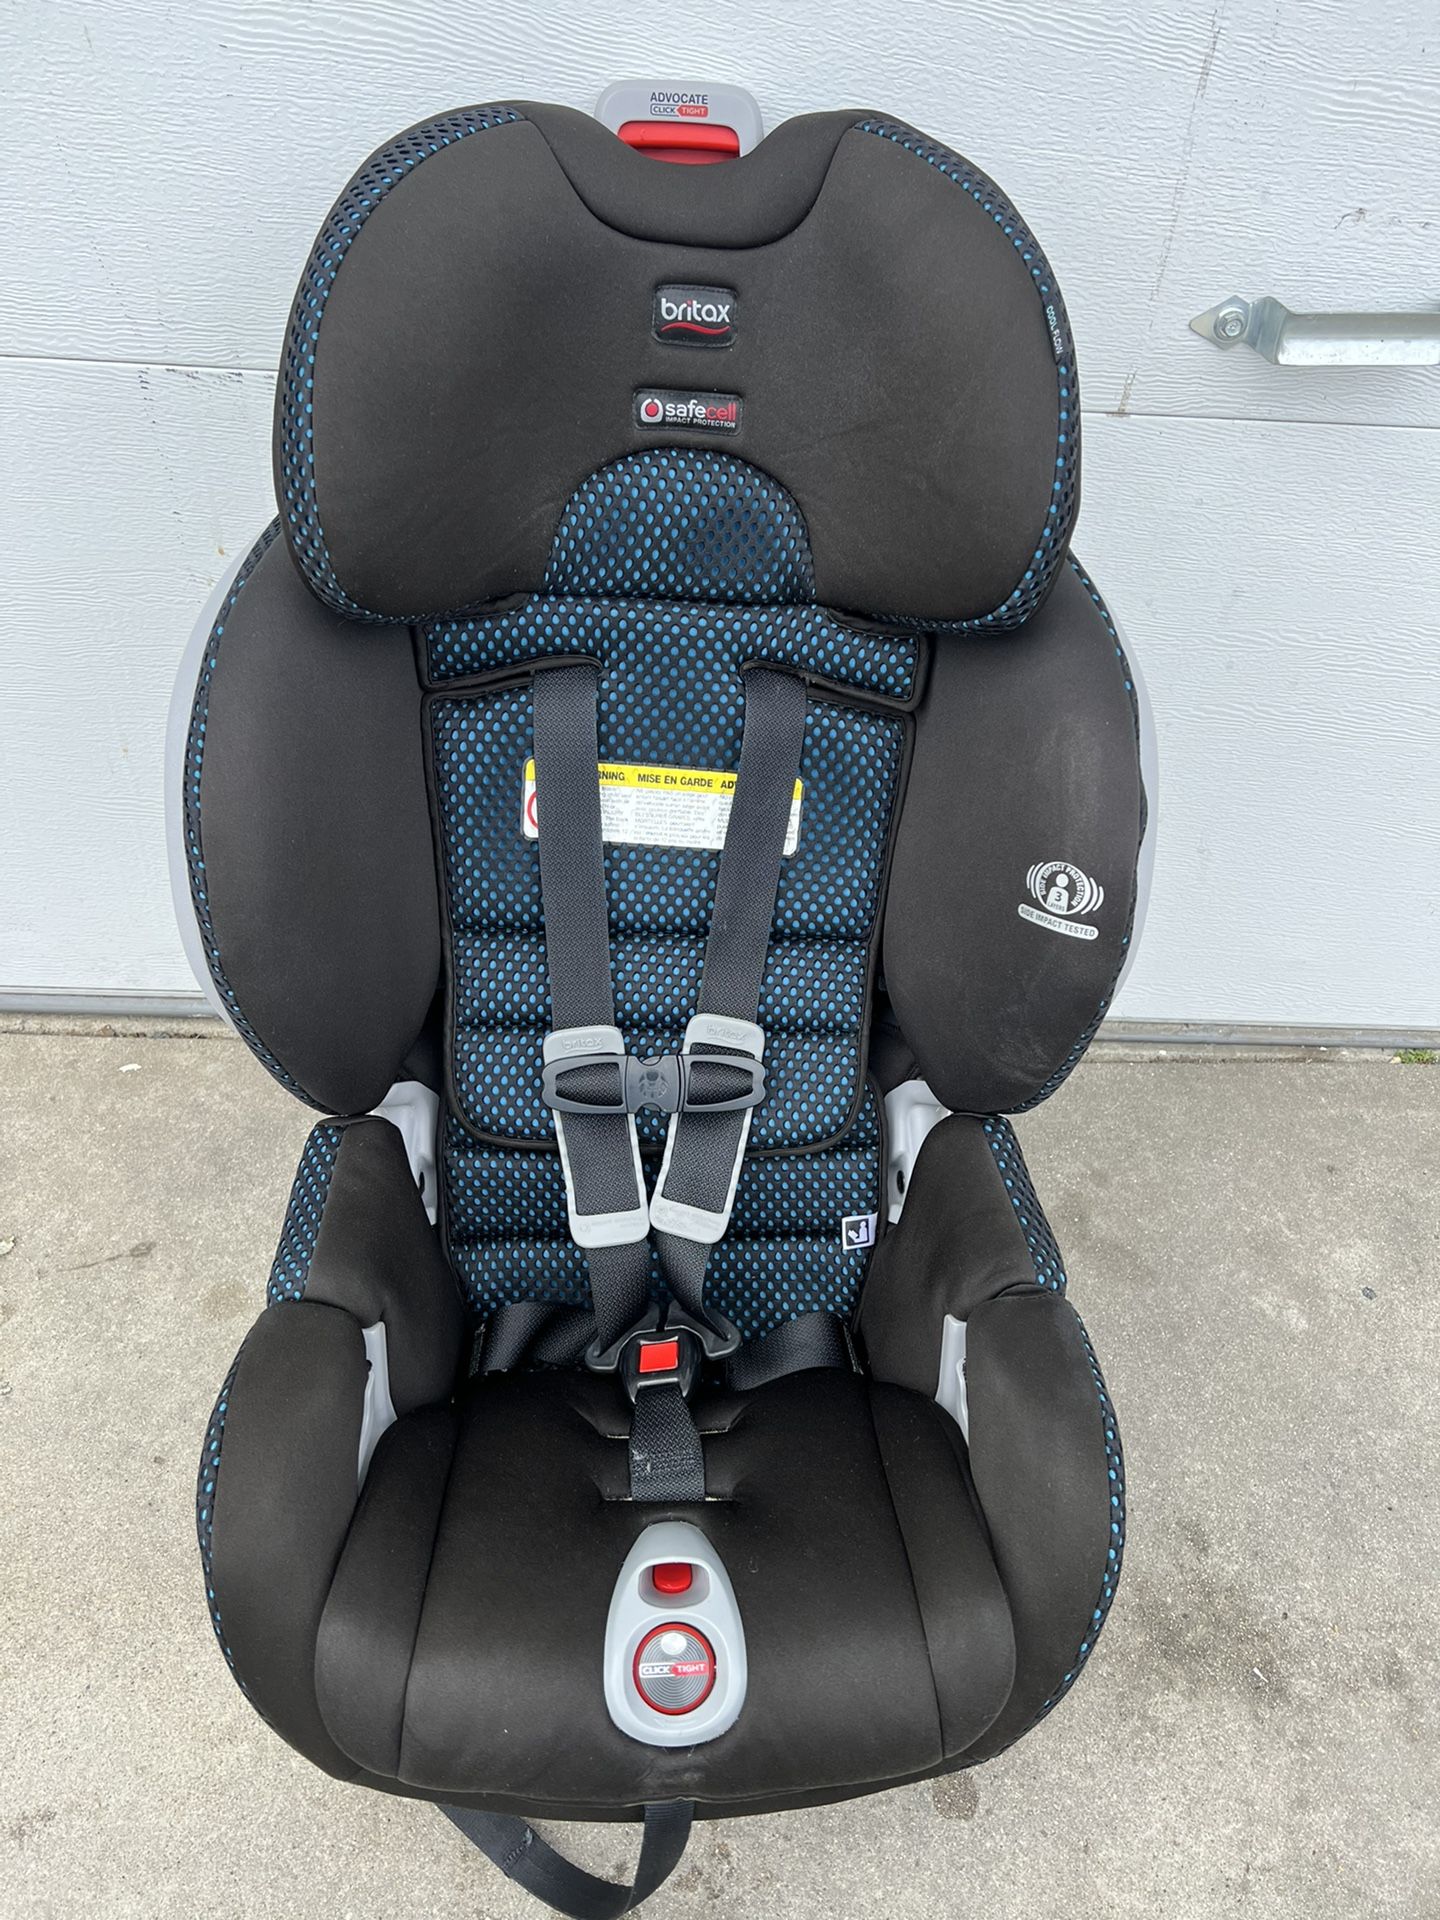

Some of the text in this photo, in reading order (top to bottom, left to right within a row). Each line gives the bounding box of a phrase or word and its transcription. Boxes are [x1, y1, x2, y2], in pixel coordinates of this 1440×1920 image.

[650, 92, 708, 105] ADVOCATE
[653, 105, 706, 115] CLICK TIGHT
[661, 298, 731, 323] britax
[665, 400, 736, 421] safecell
[665, 416, 736, 429] IMPACT PROTECTION
[638, 773, 661, 784] MISE
[664, 775, 677, 785] EN
[680, 776, 713, 788] GARDE
[720, 780, 736, 789] AD
[1054, 891, 1063, 902] 3
[1047, 902, 1066, 912] LAYERS
[1020, 905, 1096, 937] SIDE IMPACT TESTED
[642, 1663, 706, 1675] CLICK TIGHT
